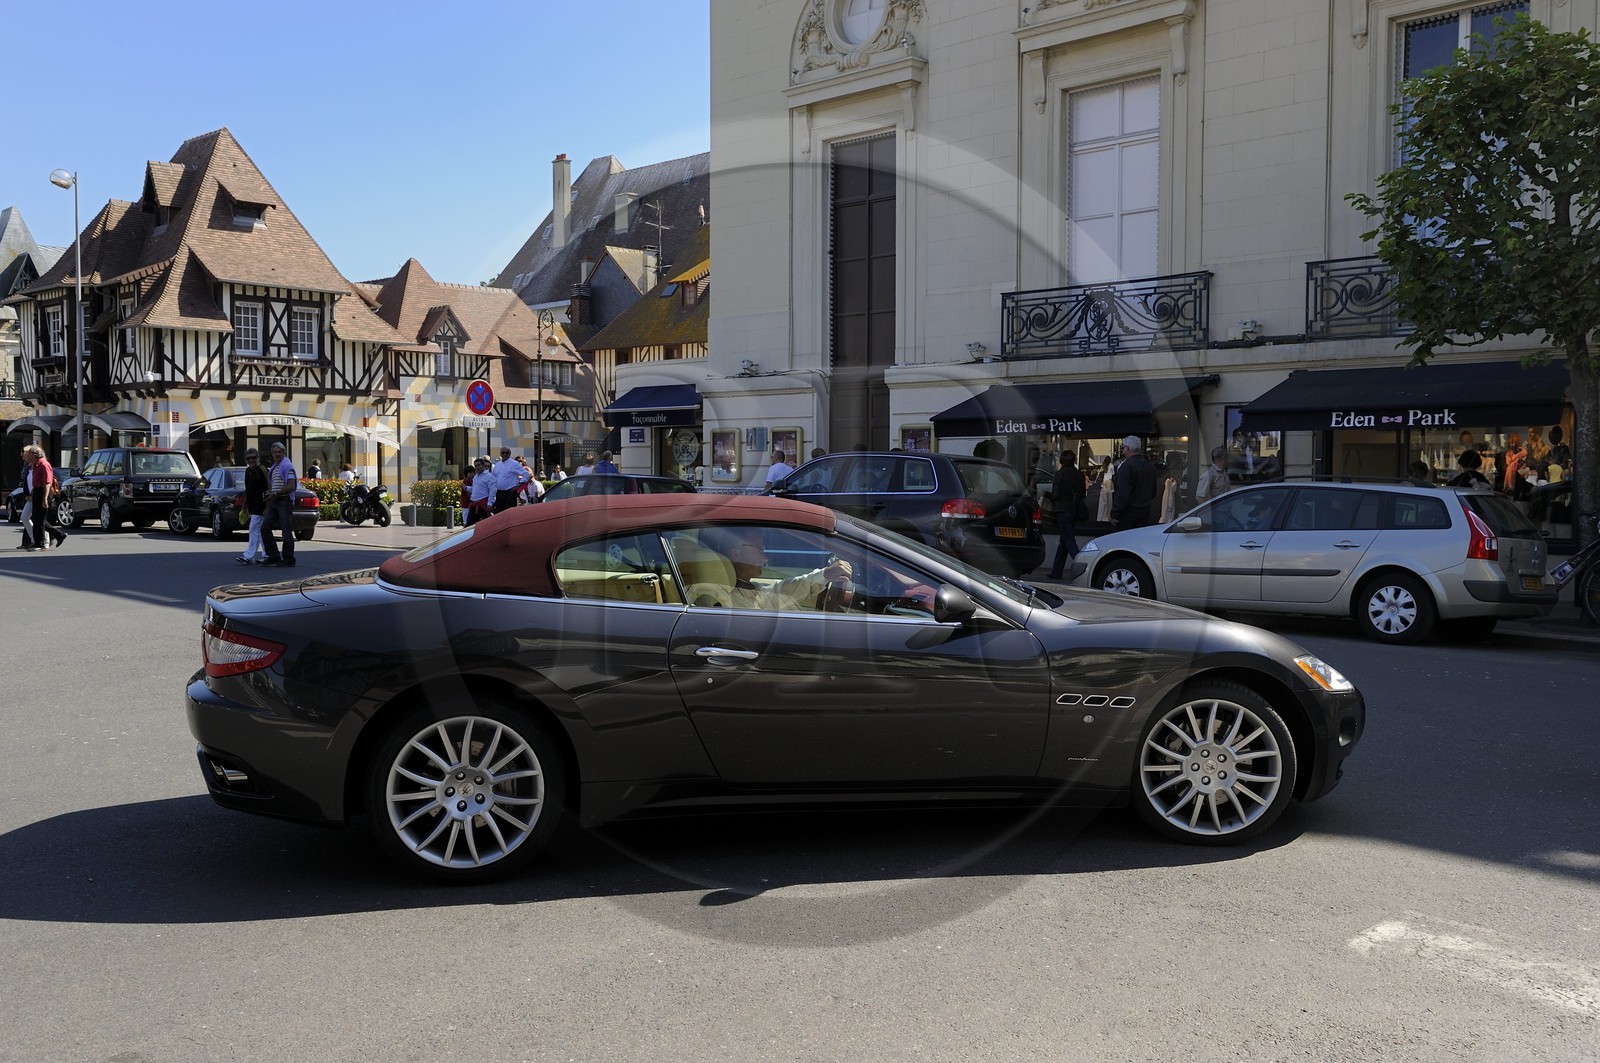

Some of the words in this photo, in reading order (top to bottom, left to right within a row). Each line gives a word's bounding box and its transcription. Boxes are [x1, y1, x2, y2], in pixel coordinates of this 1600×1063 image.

[631, 411, 667, 425] Façonnable
[996, 419, 1027, 433] Eden
[1049, 418, 1082, 432] Park
[1329, 411, 1375, 428] Eden
[1407, 409, 1456, 426] Park
